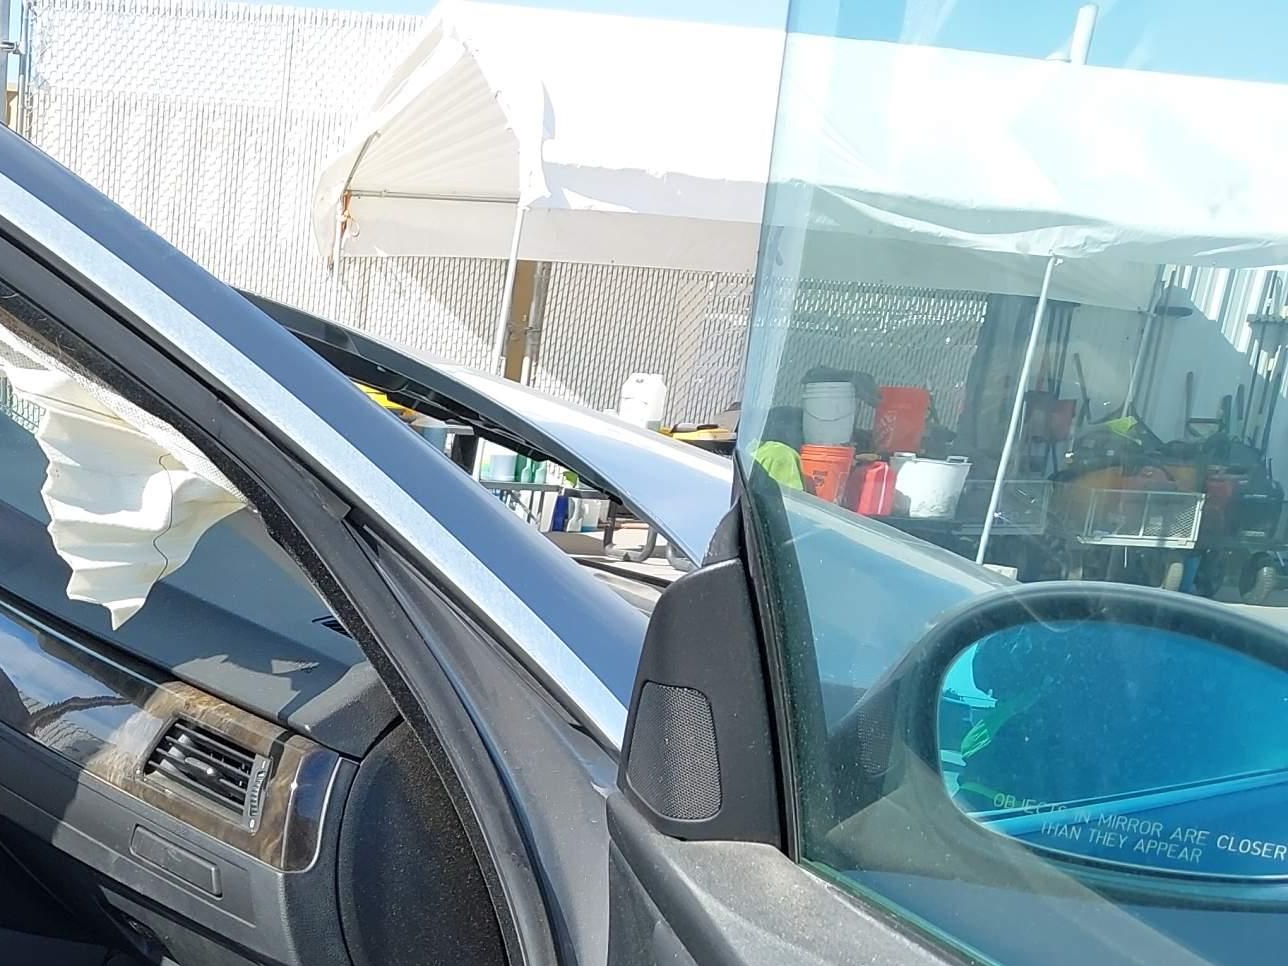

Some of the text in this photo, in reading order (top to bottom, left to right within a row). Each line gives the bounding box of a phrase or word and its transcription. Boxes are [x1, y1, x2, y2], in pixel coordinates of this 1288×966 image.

[1040, 821, 1203, 864] THAN THEY APPEAR
[1073, 809, 1091, 823] IN
[1097, 813, 1164, 838] MIRROR
[1169, 827, 1211, 846] ARE
[1216, 834, 1288, 861] CLOSER
